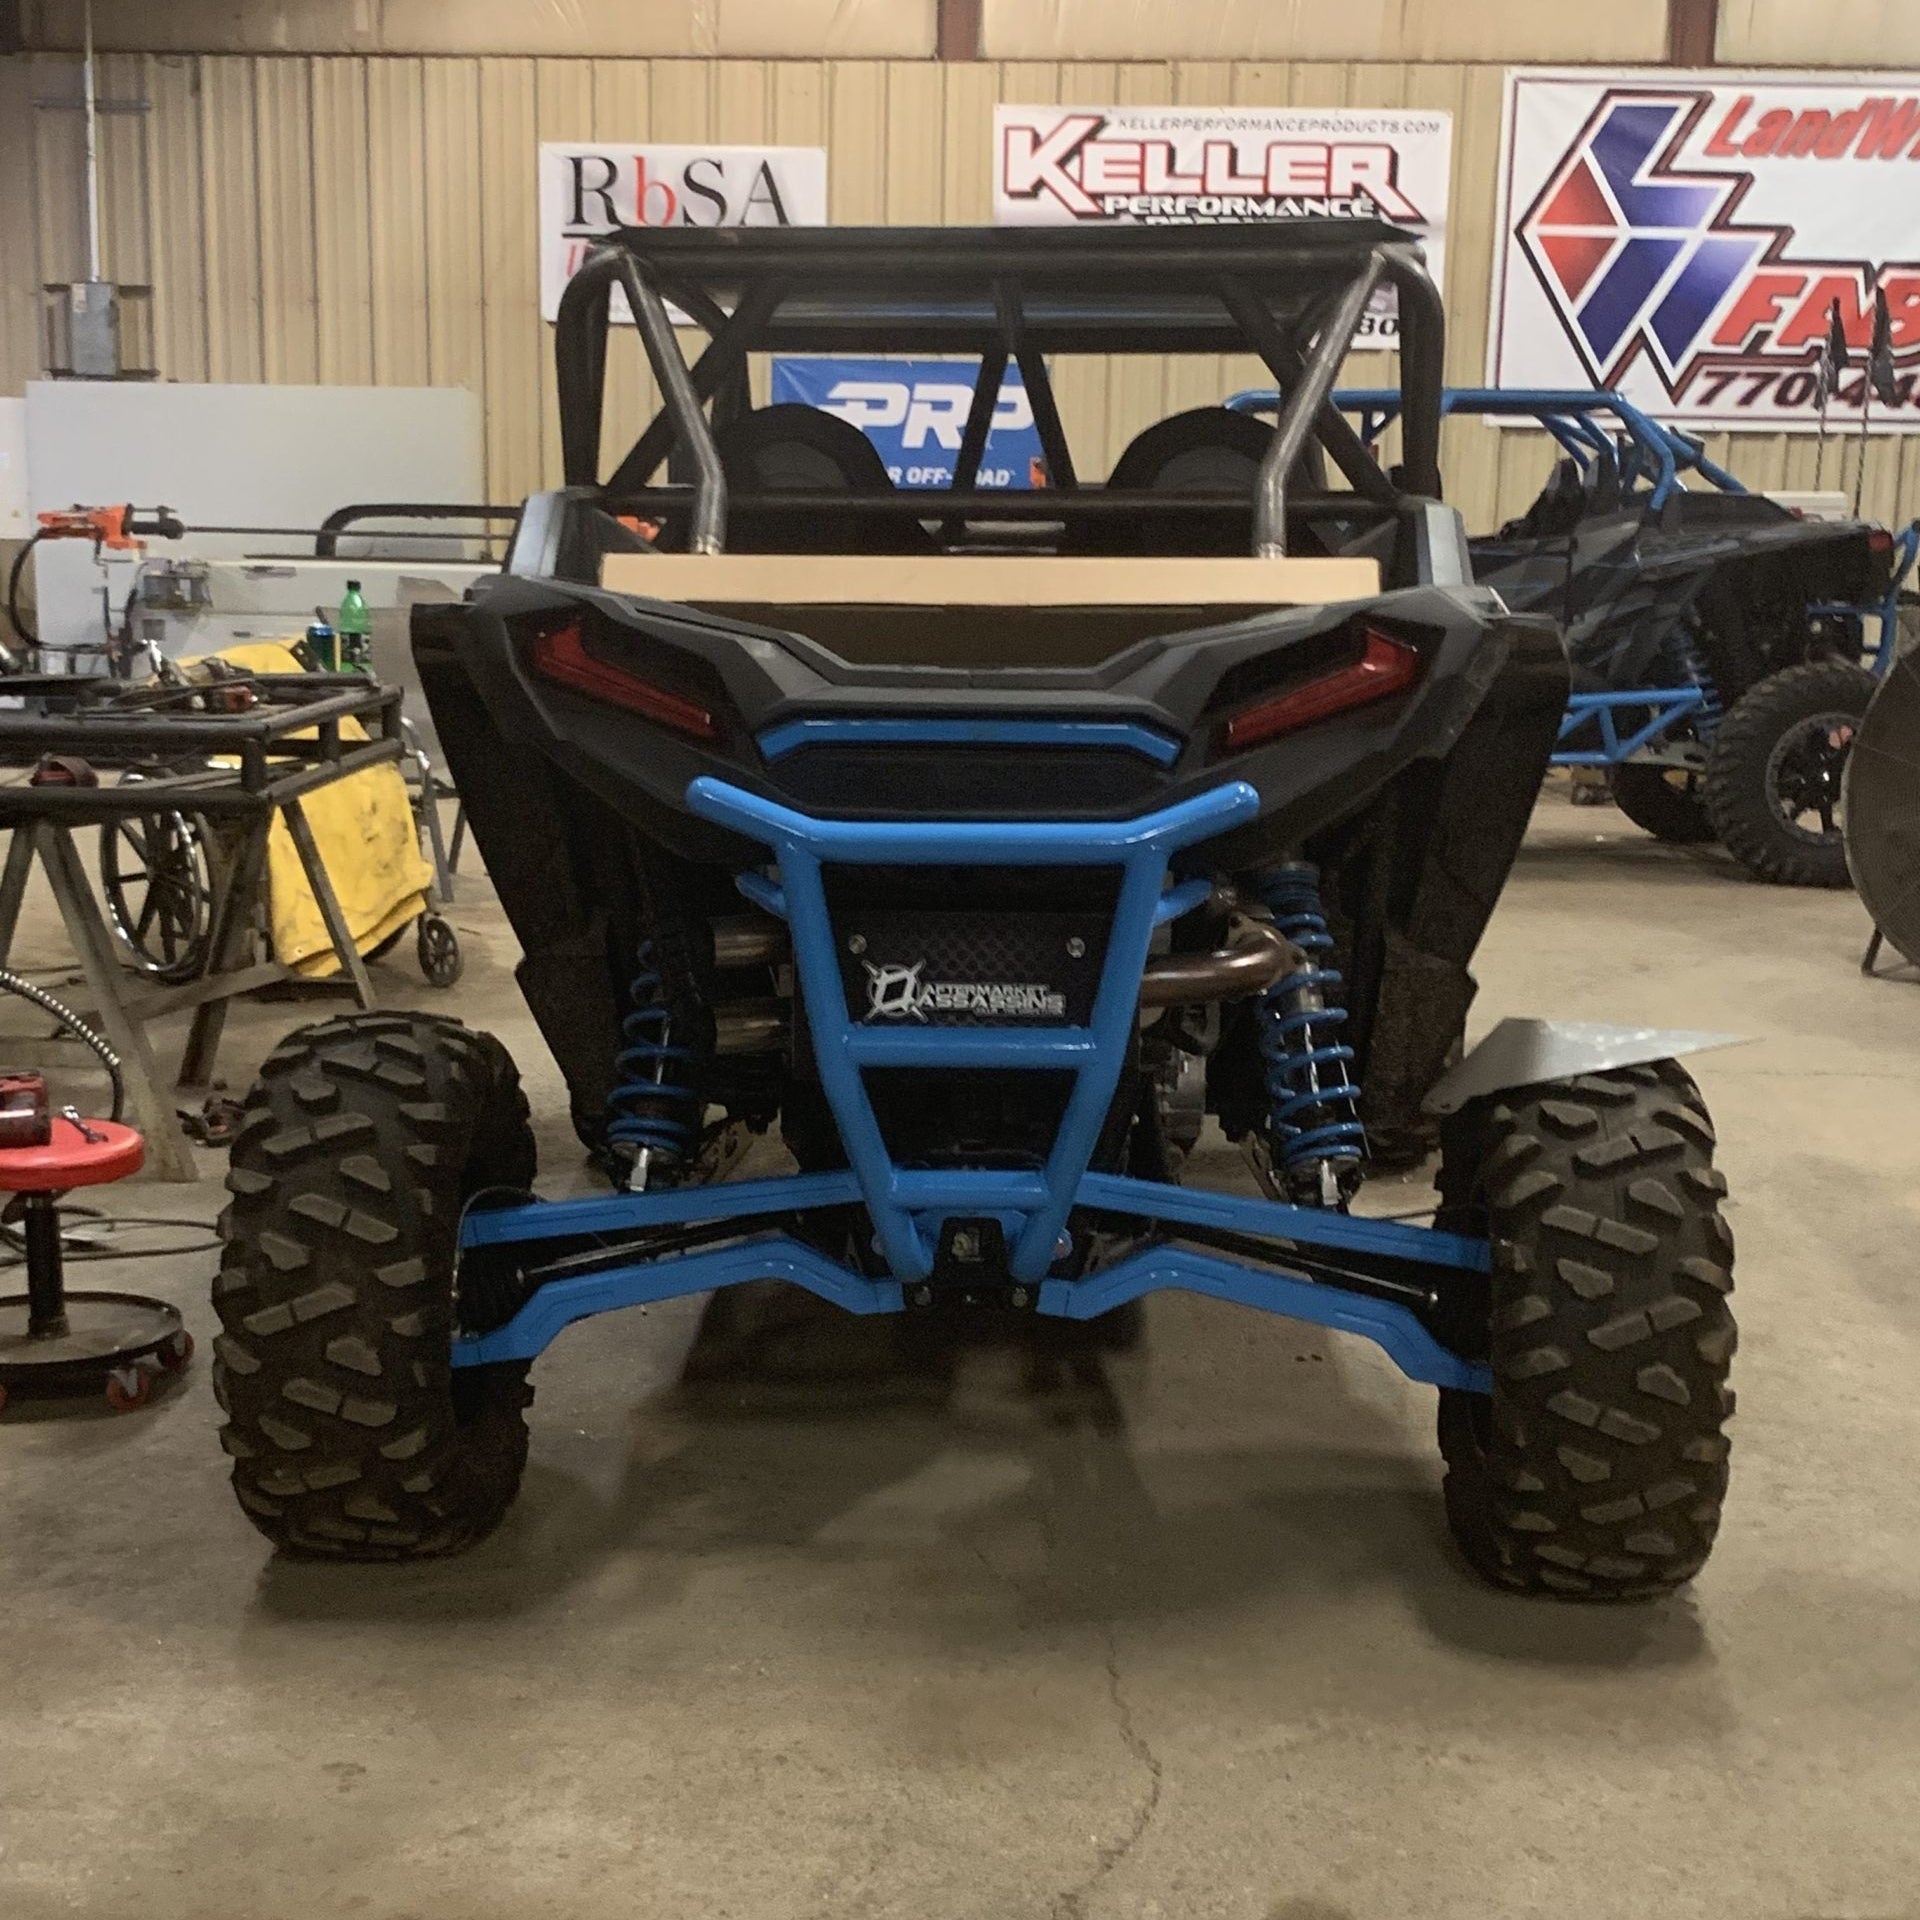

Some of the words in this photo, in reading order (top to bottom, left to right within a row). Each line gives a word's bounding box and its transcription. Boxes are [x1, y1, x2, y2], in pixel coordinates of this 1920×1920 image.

[1703, 94, 1920, 159] LandW
[563, 155, 792, 227] RbSA
[1003, 114, 1428, 223] KELLER
[1103, 194, 1375, 219] PERFORMANCE
[818, 382, 1035, 449] PRP
